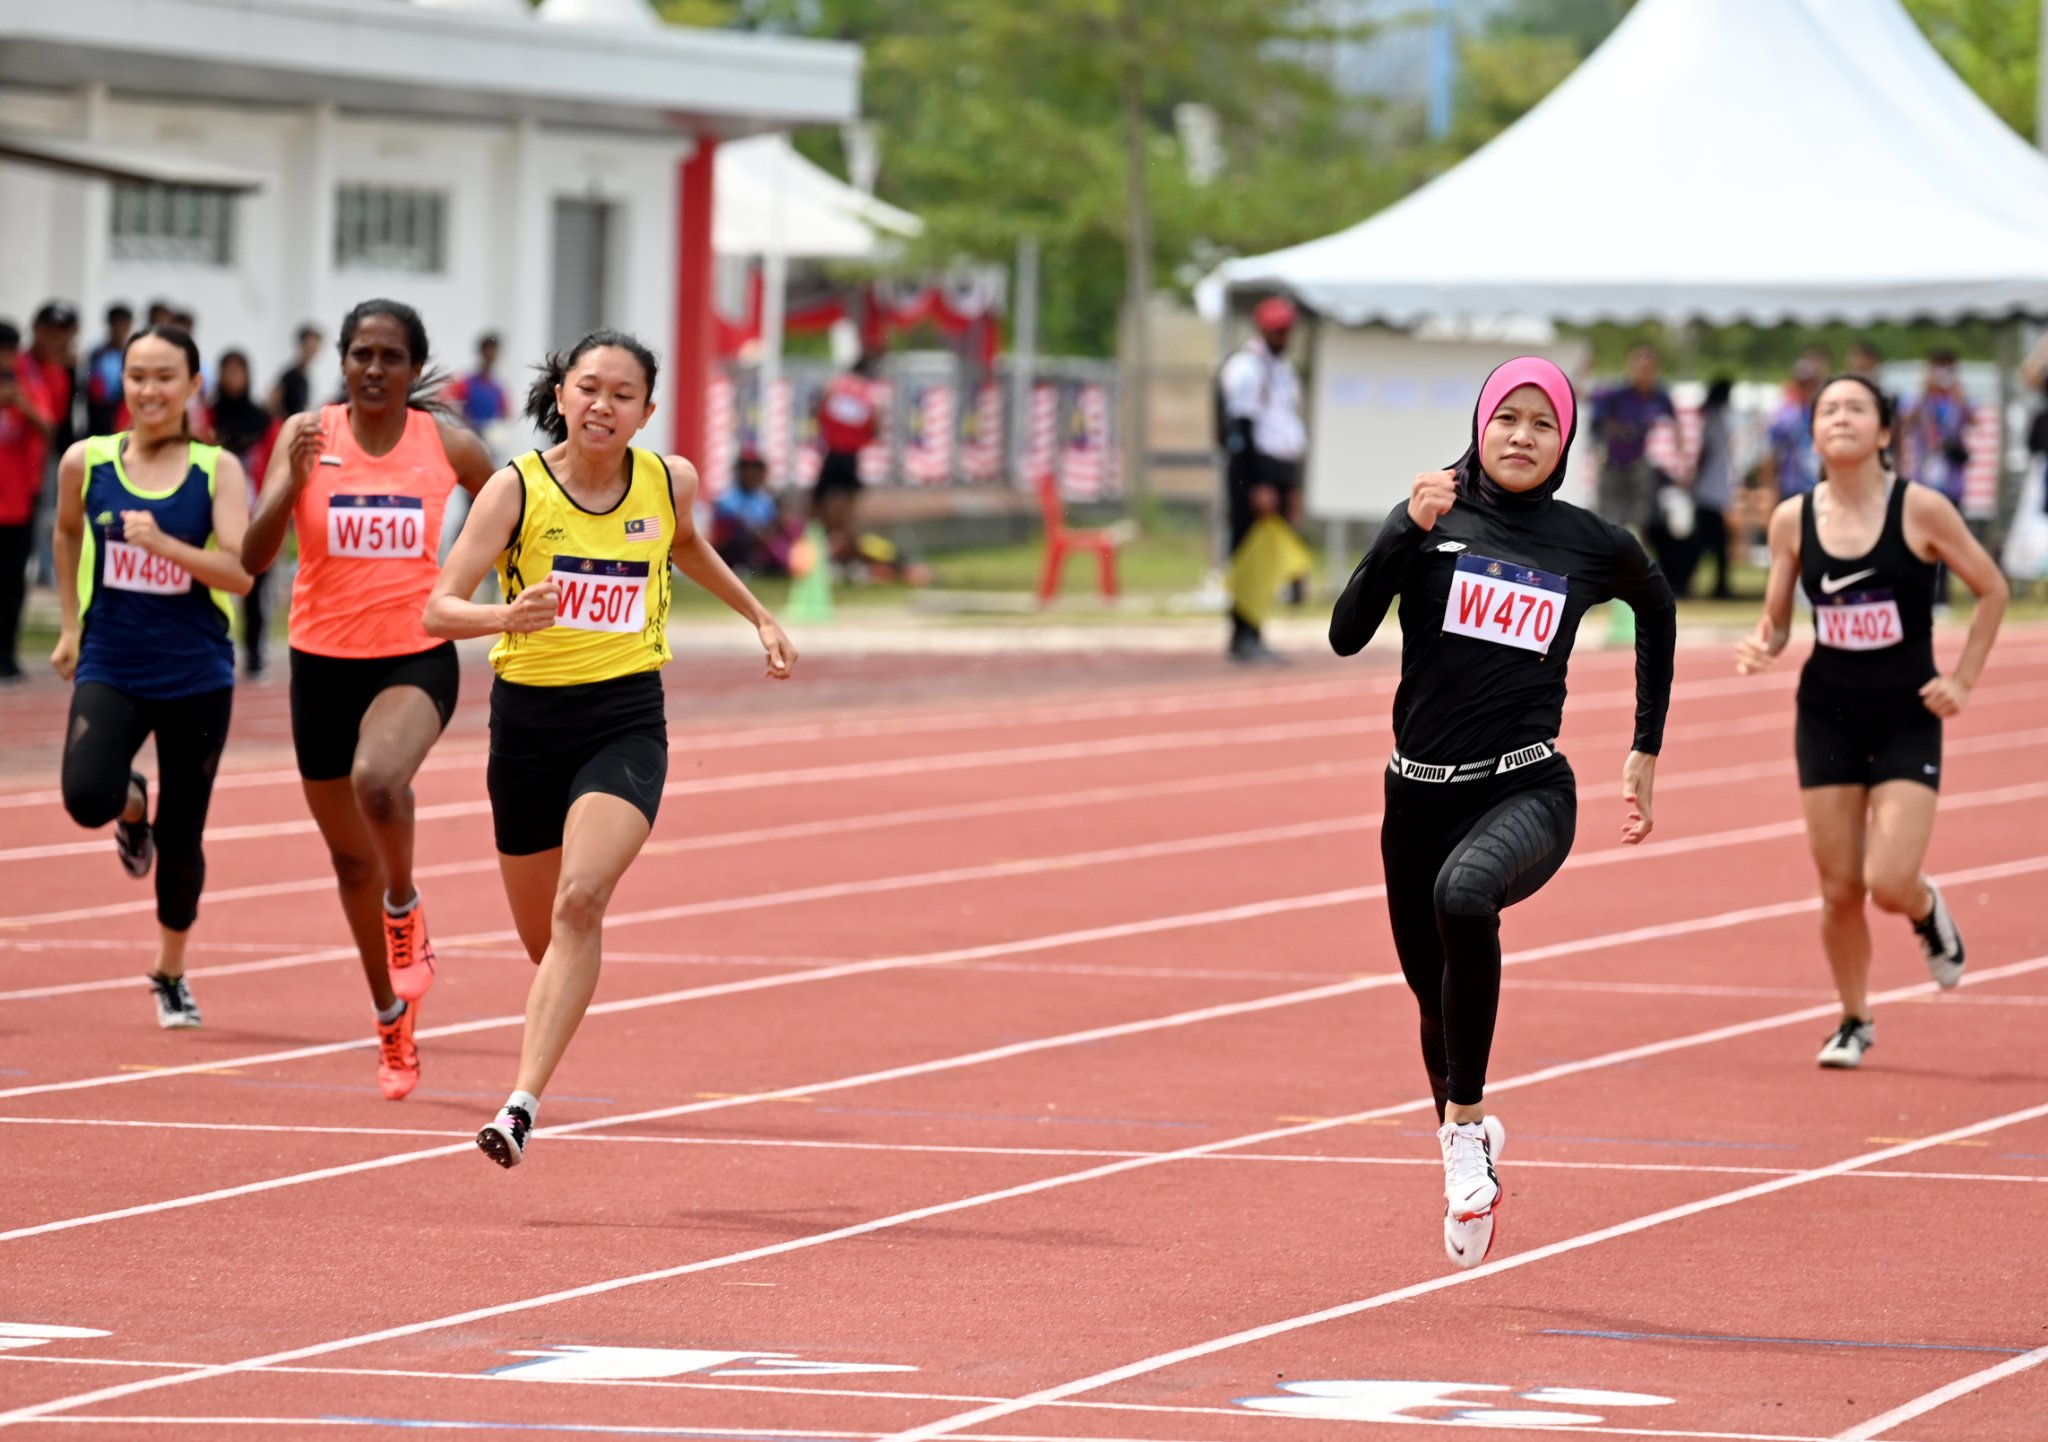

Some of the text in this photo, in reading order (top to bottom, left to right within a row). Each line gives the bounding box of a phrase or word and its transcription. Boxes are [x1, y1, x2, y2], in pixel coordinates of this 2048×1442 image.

[336, 516, 416, 550] W510
[557, 579, 639, 624] W507
[1459, 581, 1553, 643] W470
[1824, 608, 1895, 643] W402
[1404, 763, 1447, 781] PUMA
[1504, 745, 1546, 770] PUMA
